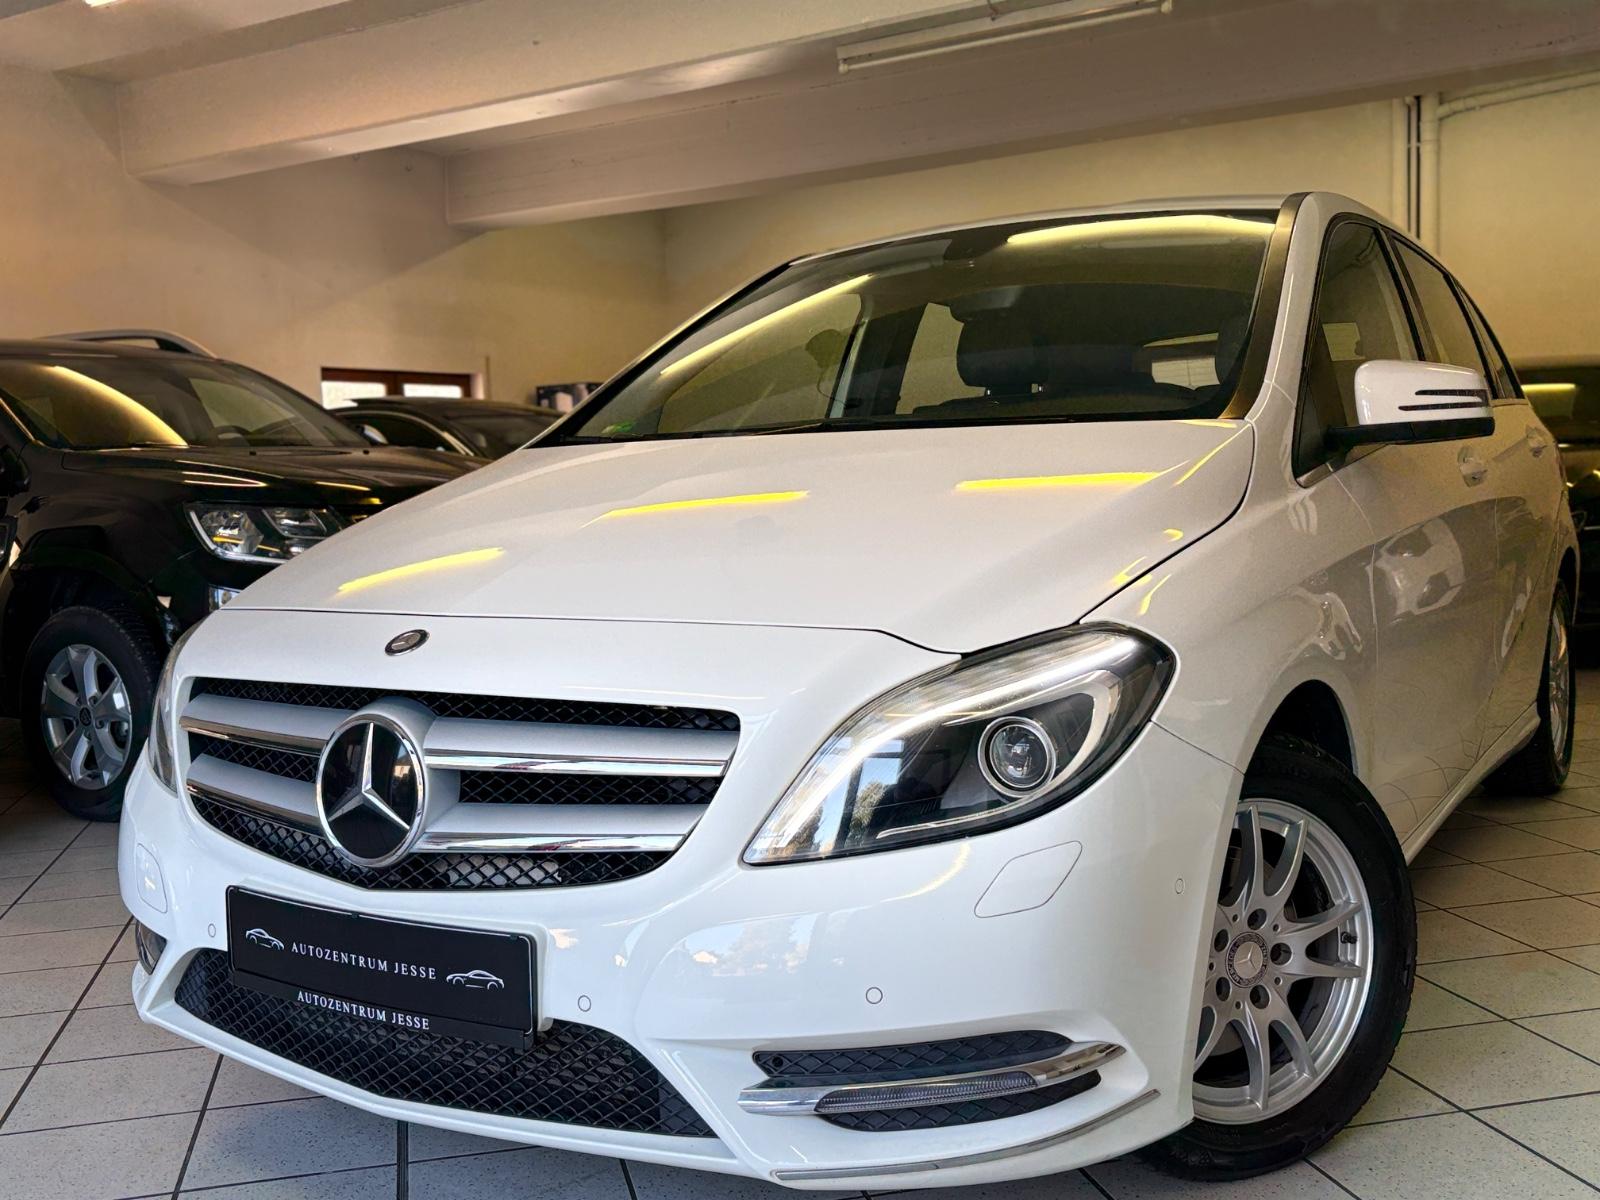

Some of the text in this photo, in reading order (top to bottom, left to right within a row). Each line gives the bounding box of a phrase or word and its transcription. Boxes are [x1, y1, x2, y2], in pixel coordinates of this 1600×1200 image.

[291, 941, 437, 980] AUTOZENTRUM JESSE
[297, 990, 430, 1031] AUTOZENTRUM JESSE
